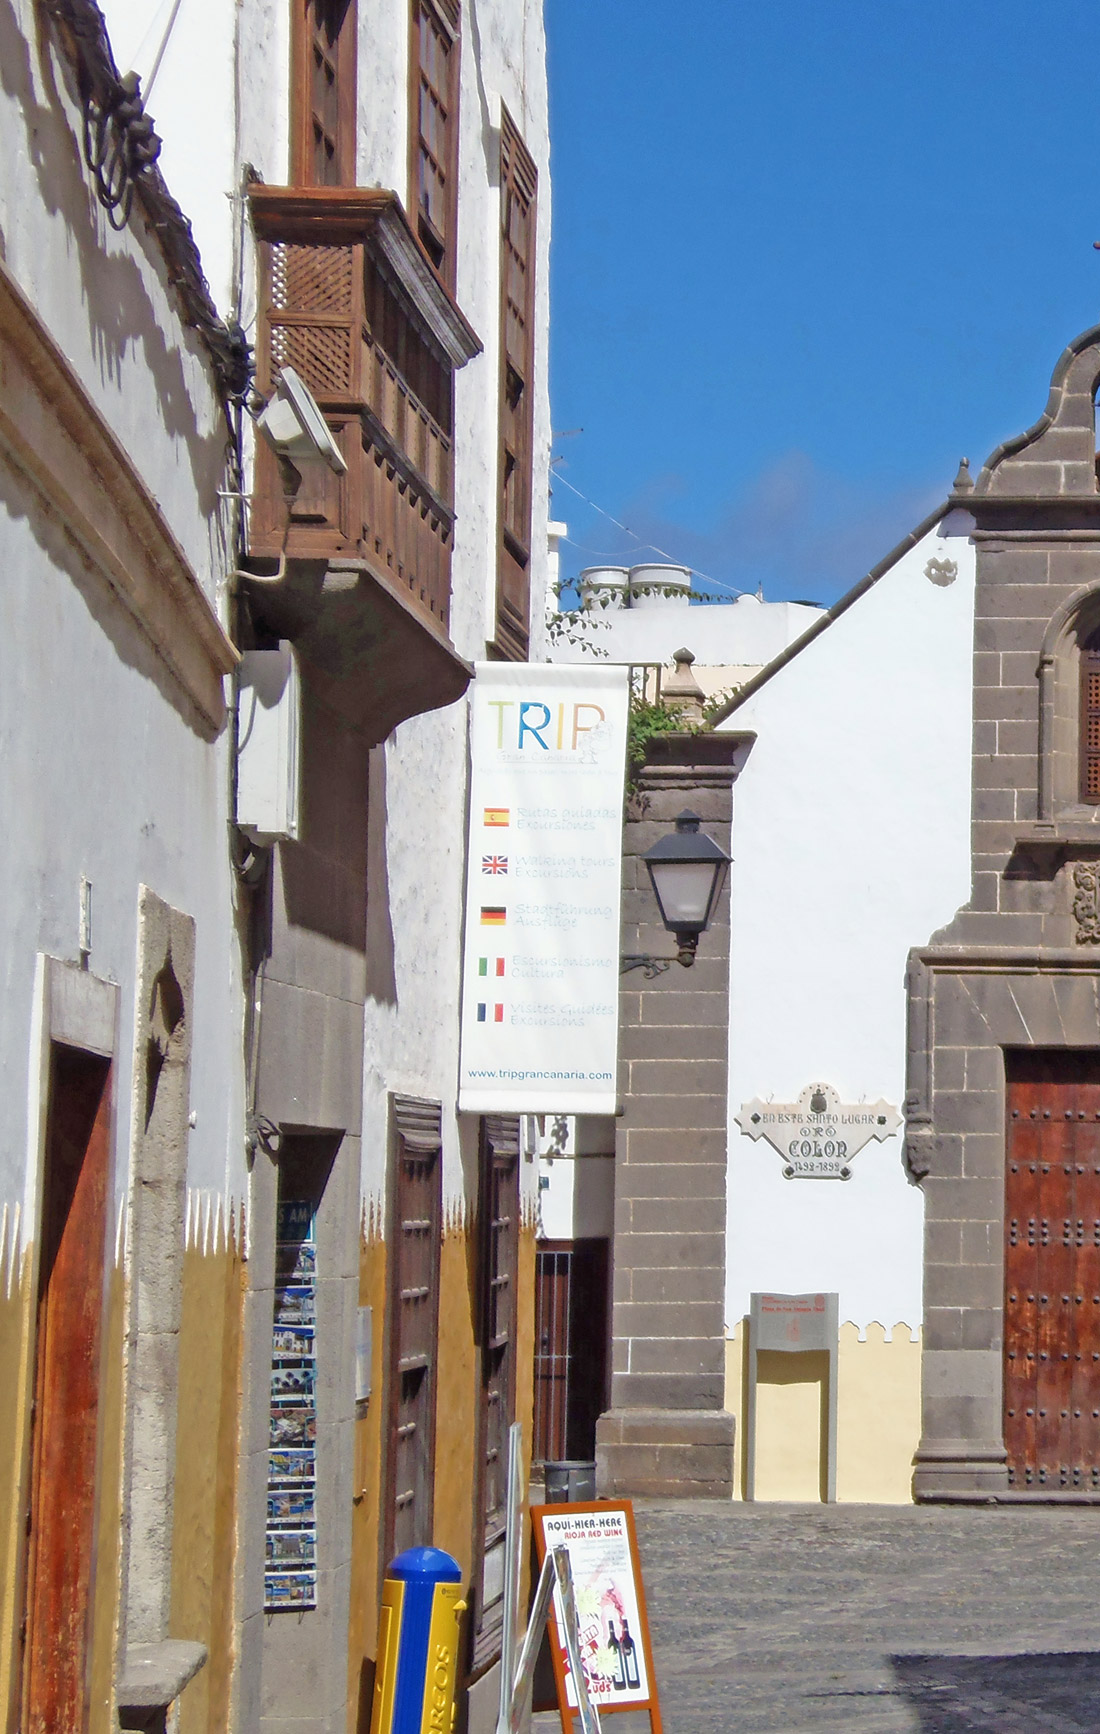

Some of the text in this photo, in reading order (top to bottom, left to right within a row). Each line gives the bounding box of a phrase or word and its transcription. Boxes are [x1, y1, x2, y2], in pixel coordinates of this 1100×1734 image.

[487, 700, 606, 751] TRIP
[516, 807, 558, 819] Rutas
[516, 818, 597, 831] Excursiones
[515, 855, 616, 870] Walking tours
[515, 867, 589, 879] Excursions
[511, 966, 565, 979] Cultura
[510, 1014, 586, 1027] Excursions
[467, 1068, 613, 1081] www.tripgrancanaria.com
[762, 1113, 875, 1125] EN ESTE SANTO LUGAR
[794, 1161, 841, 1172] 1492-1892
[564, 1528, 623, 1540] RIOJA RED WINE
